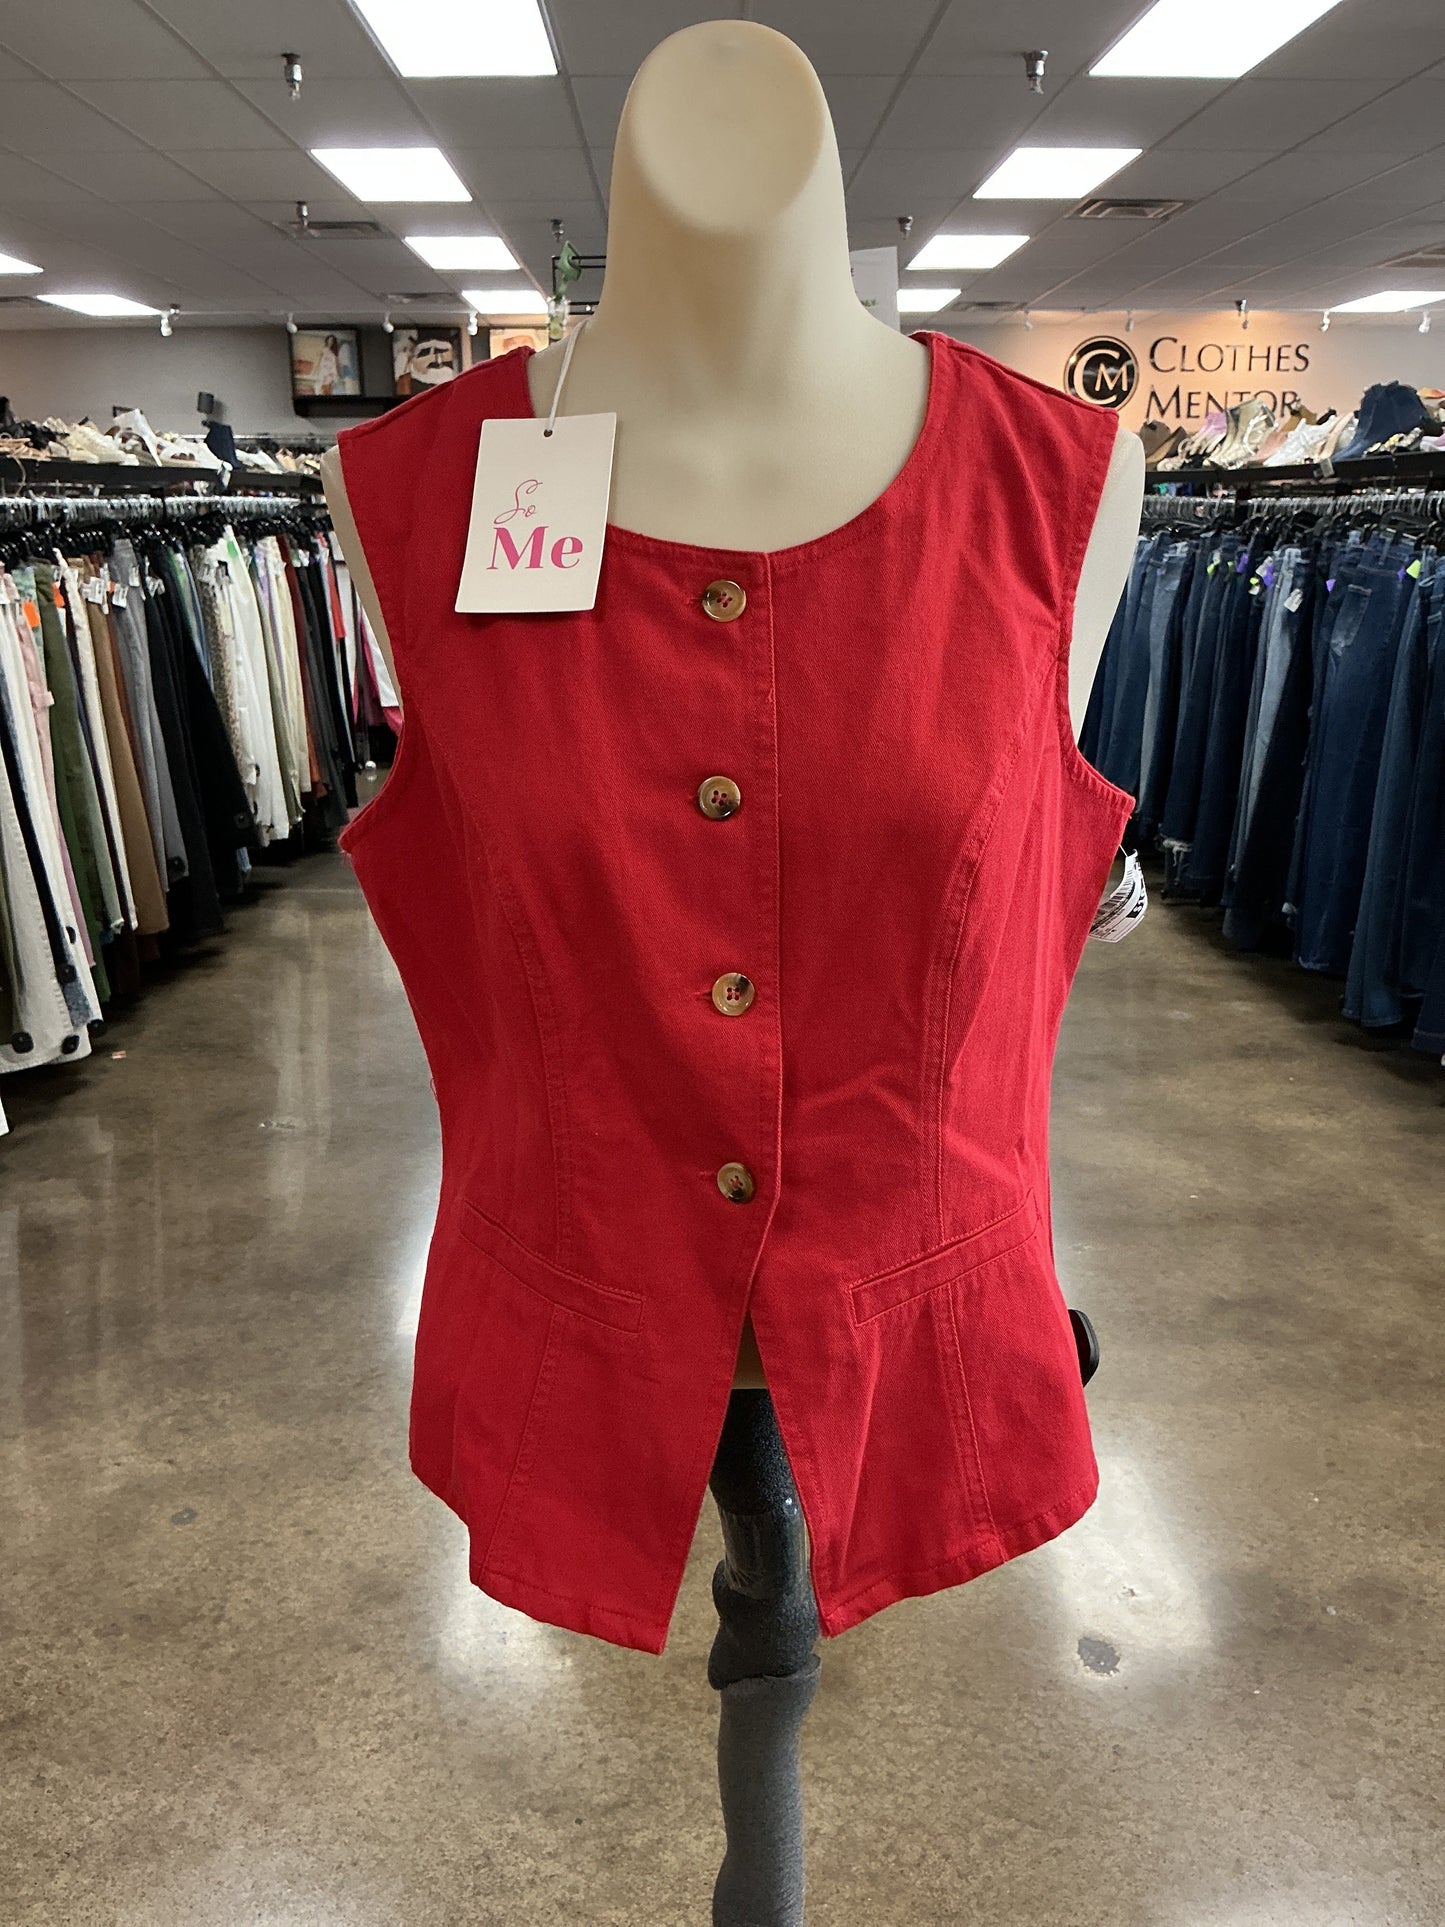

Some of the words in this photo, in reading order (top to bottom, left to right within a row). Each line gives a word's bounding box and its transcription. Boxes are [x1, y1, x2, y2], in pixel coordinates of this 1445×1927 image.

[1149, 336, 1310, 373] CLOTHES
[493, 479, 543, 525] So
[486, 525, 584, 570] Me
